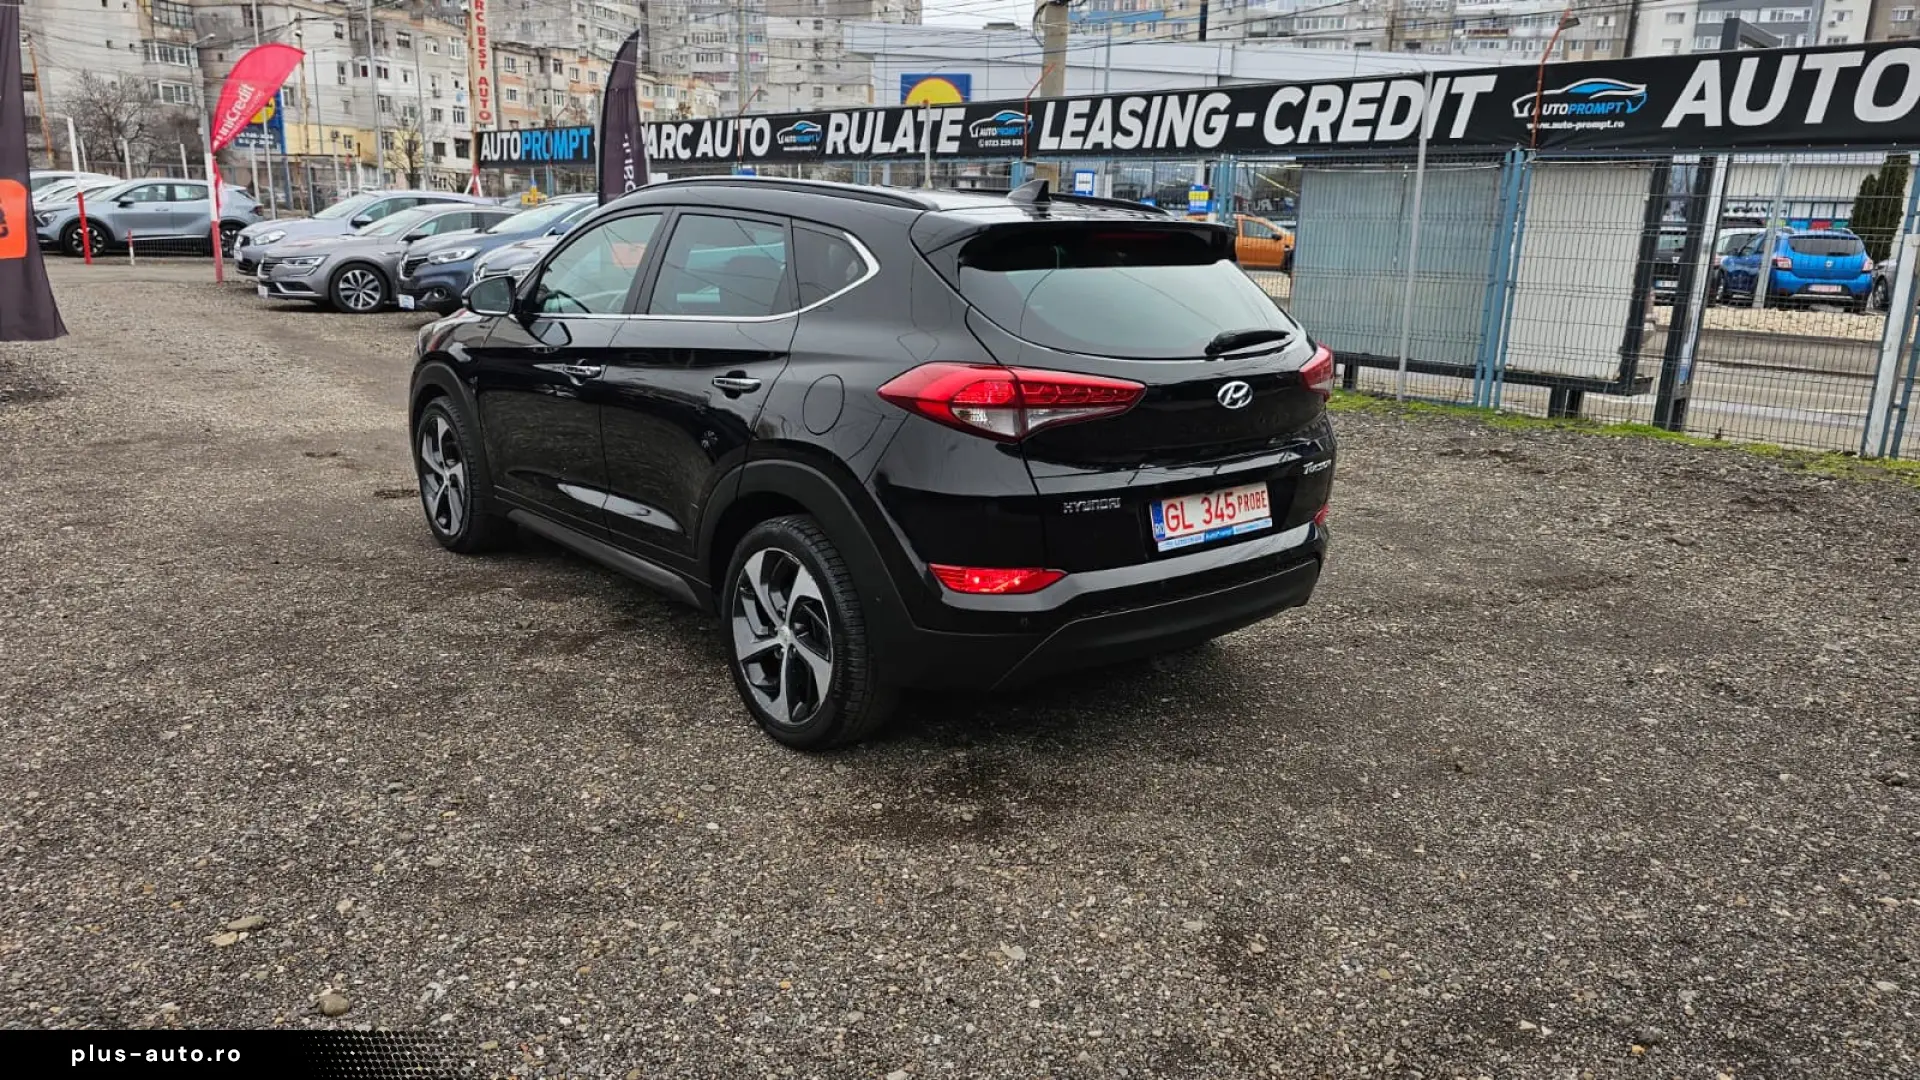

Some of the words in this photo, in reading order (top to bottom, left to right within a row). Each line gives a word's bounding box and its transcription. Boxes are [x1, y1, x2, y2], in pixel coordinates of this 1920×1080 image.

[476, 26, 487, 70] BEST
[478, 77, 491, 120] AUTO
[1661, 47, 1920, 128] AUTO
[480, 127, 592, 162] AUTOPROMPT
[695, 117, 771, 158] AUTO
[825, 107, 966, 154] RULATE
[1063, 497, 1121, 514] HYUNDAI
[1164, 501, 1194, 532] GL
[1201, 491, 1236, 525] 345
[1237, 490, 1268, 513] PROBE
